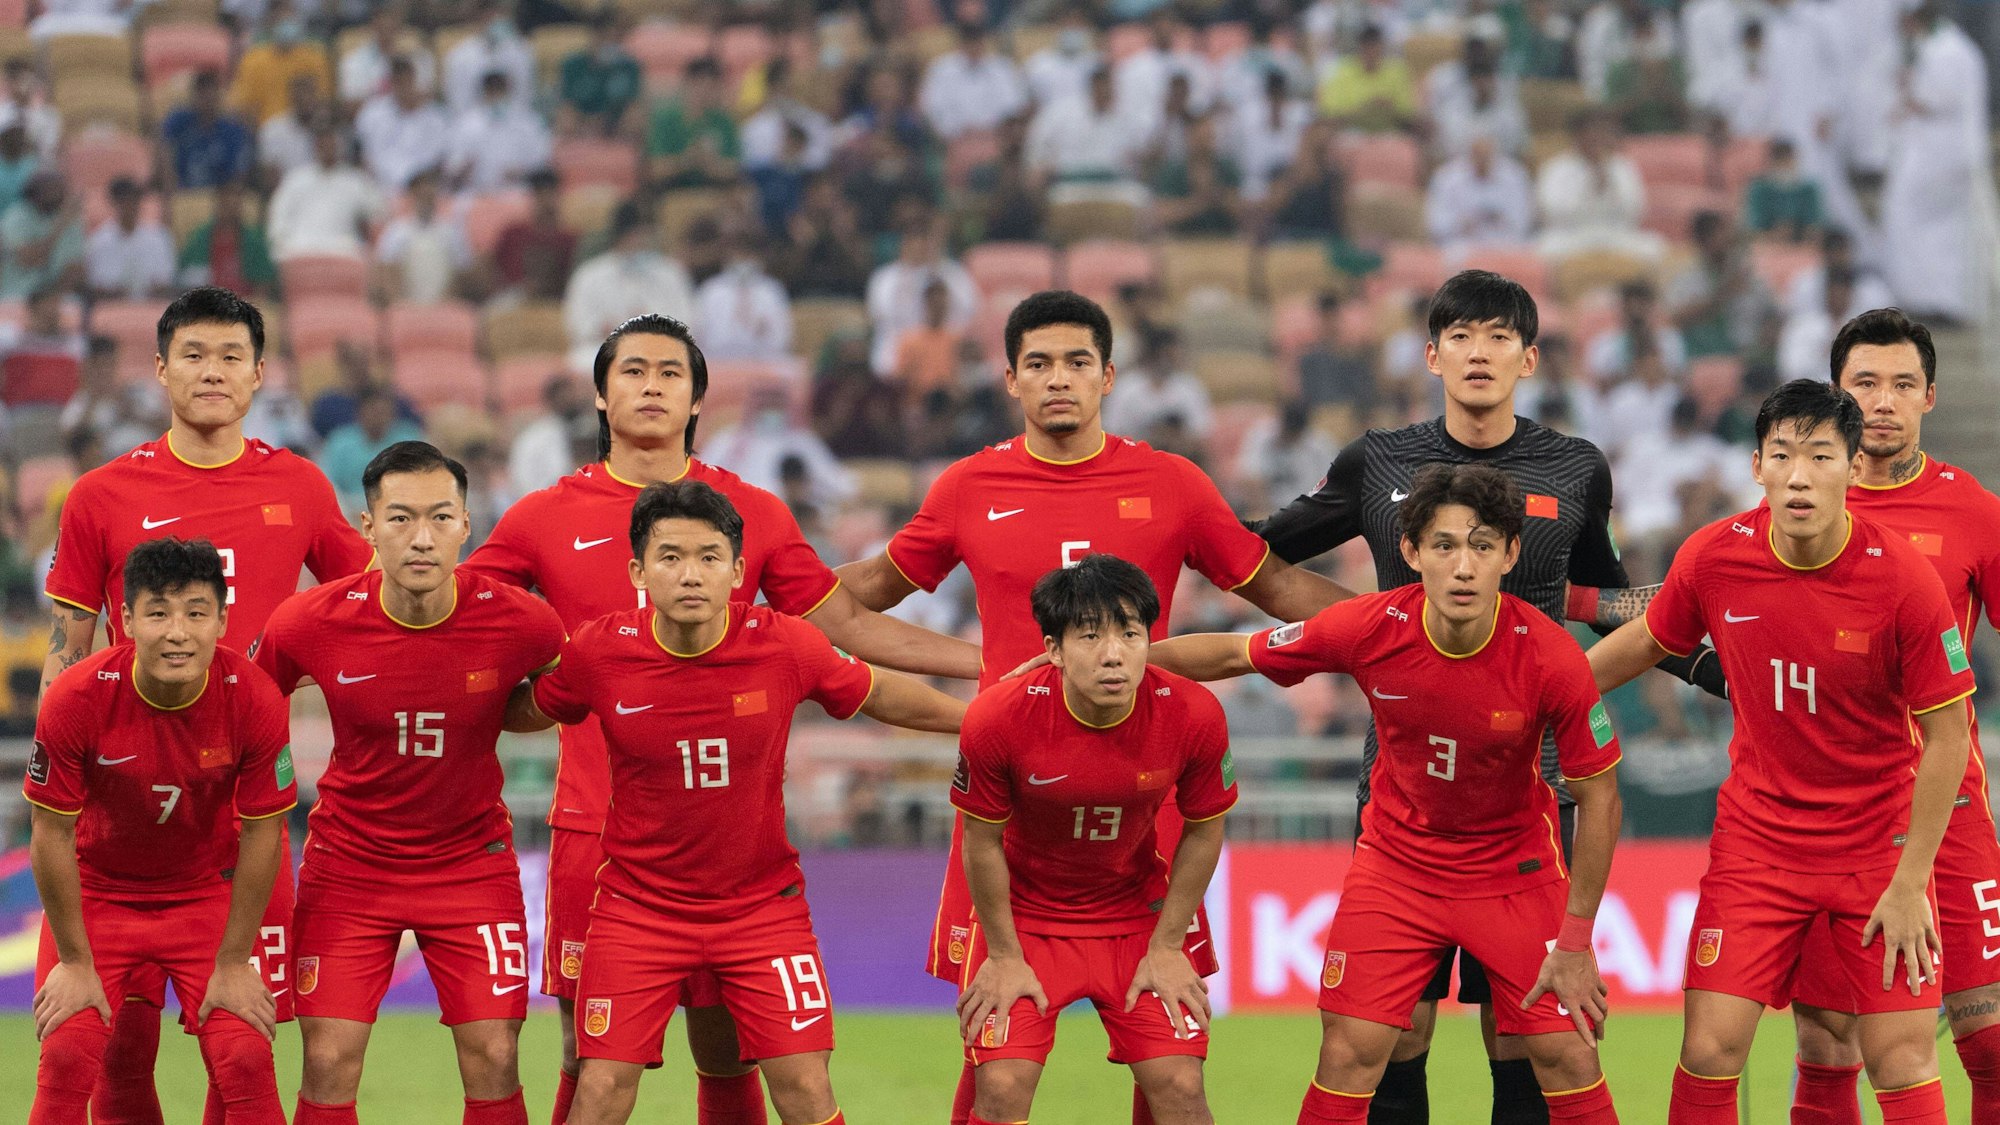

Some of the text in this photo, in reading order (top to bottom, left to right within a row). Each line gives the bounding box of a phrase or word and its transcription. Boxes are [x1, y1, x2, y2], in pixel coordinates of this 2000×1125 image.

[1732, 521, 1755, 538] CFA
[347, 590, 369, 601] CFA
[618, 625, 639, 637] CFA
[1386, 606, 1409, 623] CFA
[97, 670, 121, 681] CFA
[1027, 685, 1050, 696] CFA
[1770, 658, 1817, 714] 14
[394, 711, 446, 758] 15
[676, 738, 730, 790] 19
[1427, 734, 1457, 782] 3
[152, 784, 182, 825] 7
[1072, 806, 1122, 841] 13
[476, 922, 527, 977] 15
[771, 954, 827, 1011] 19
[588, 1002, 608, 1010] CFA
